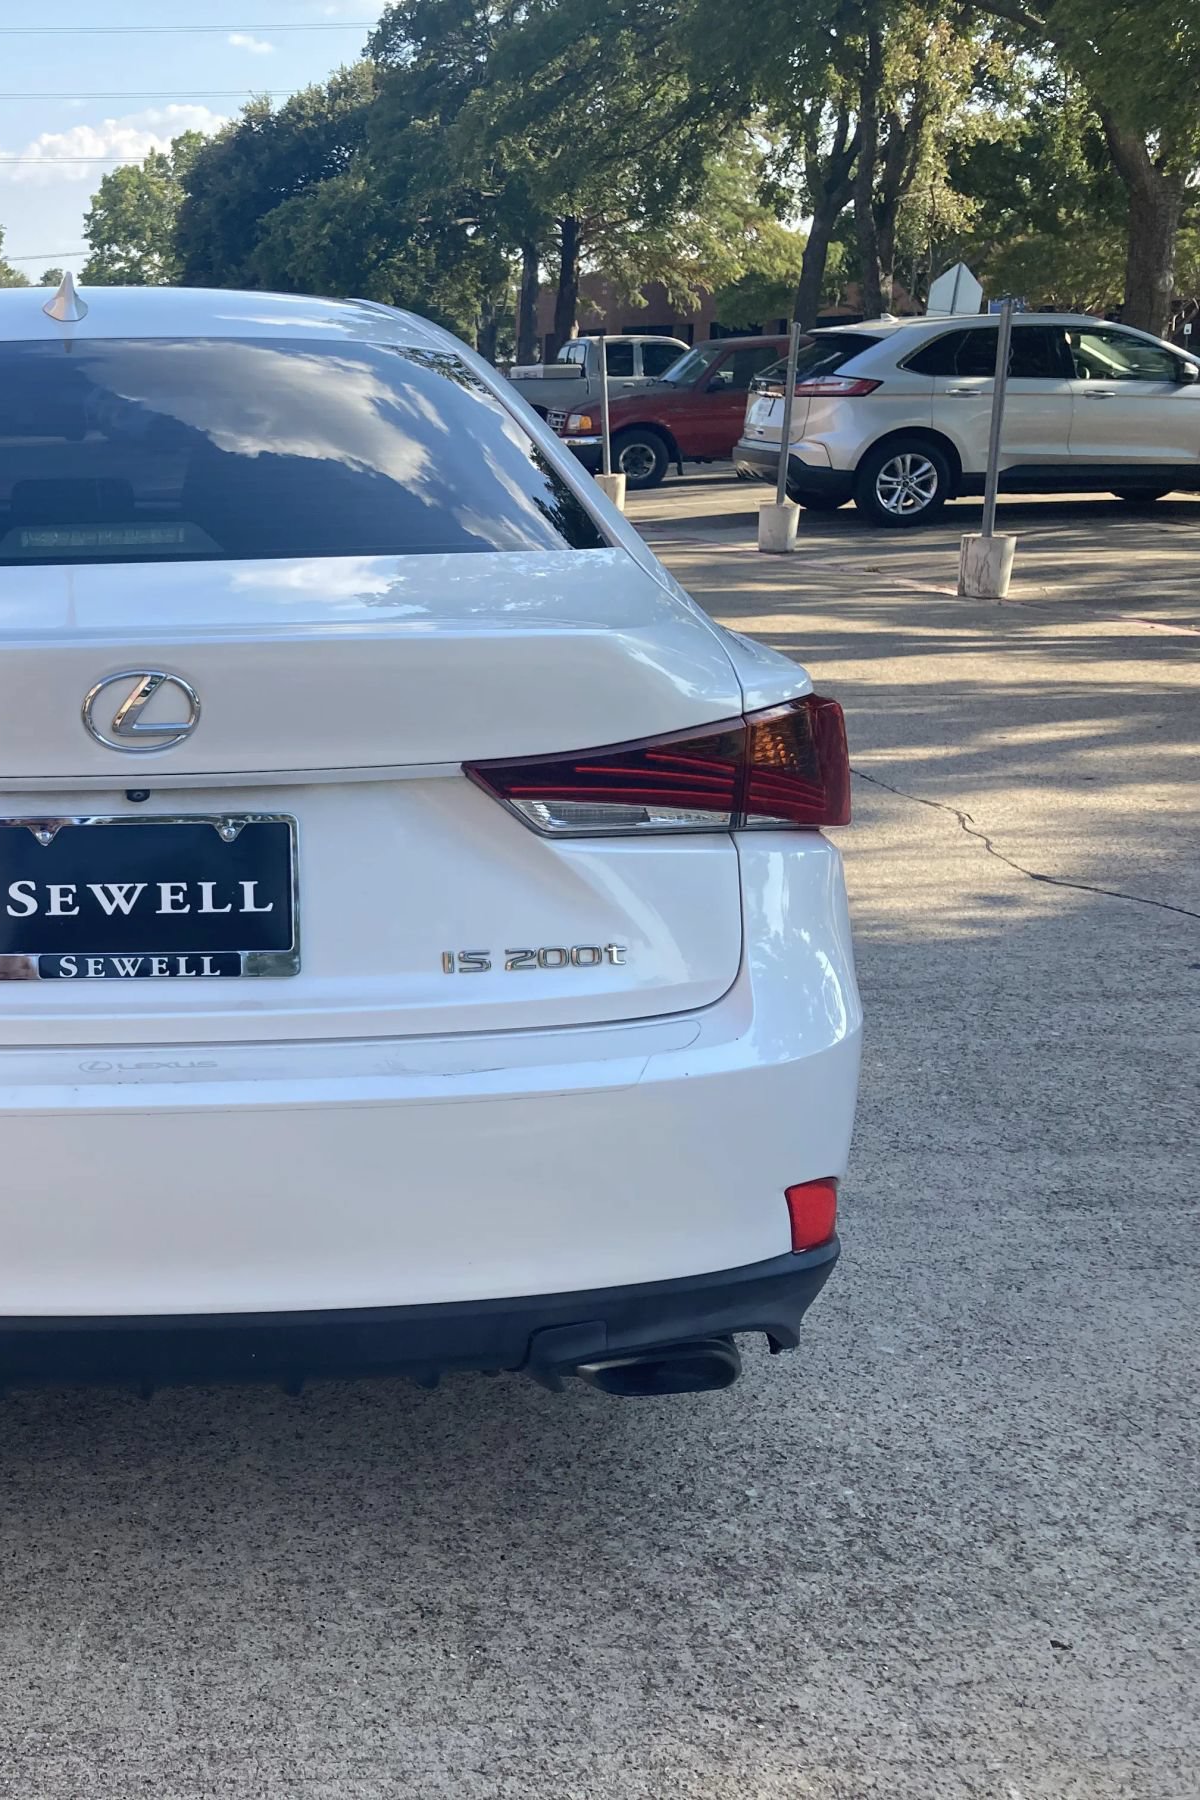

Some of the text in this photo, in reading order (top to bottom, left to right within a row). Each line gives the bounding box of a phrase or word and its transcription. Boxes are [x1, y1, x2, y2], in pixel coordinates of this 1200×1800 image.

[6, 880, 274, 917] SEWELL
[59, 955, 221, 978] SEWELL
[442, 943, 628, 974] IS 200t
[116, 1060, 219, 1071] LEXUS
